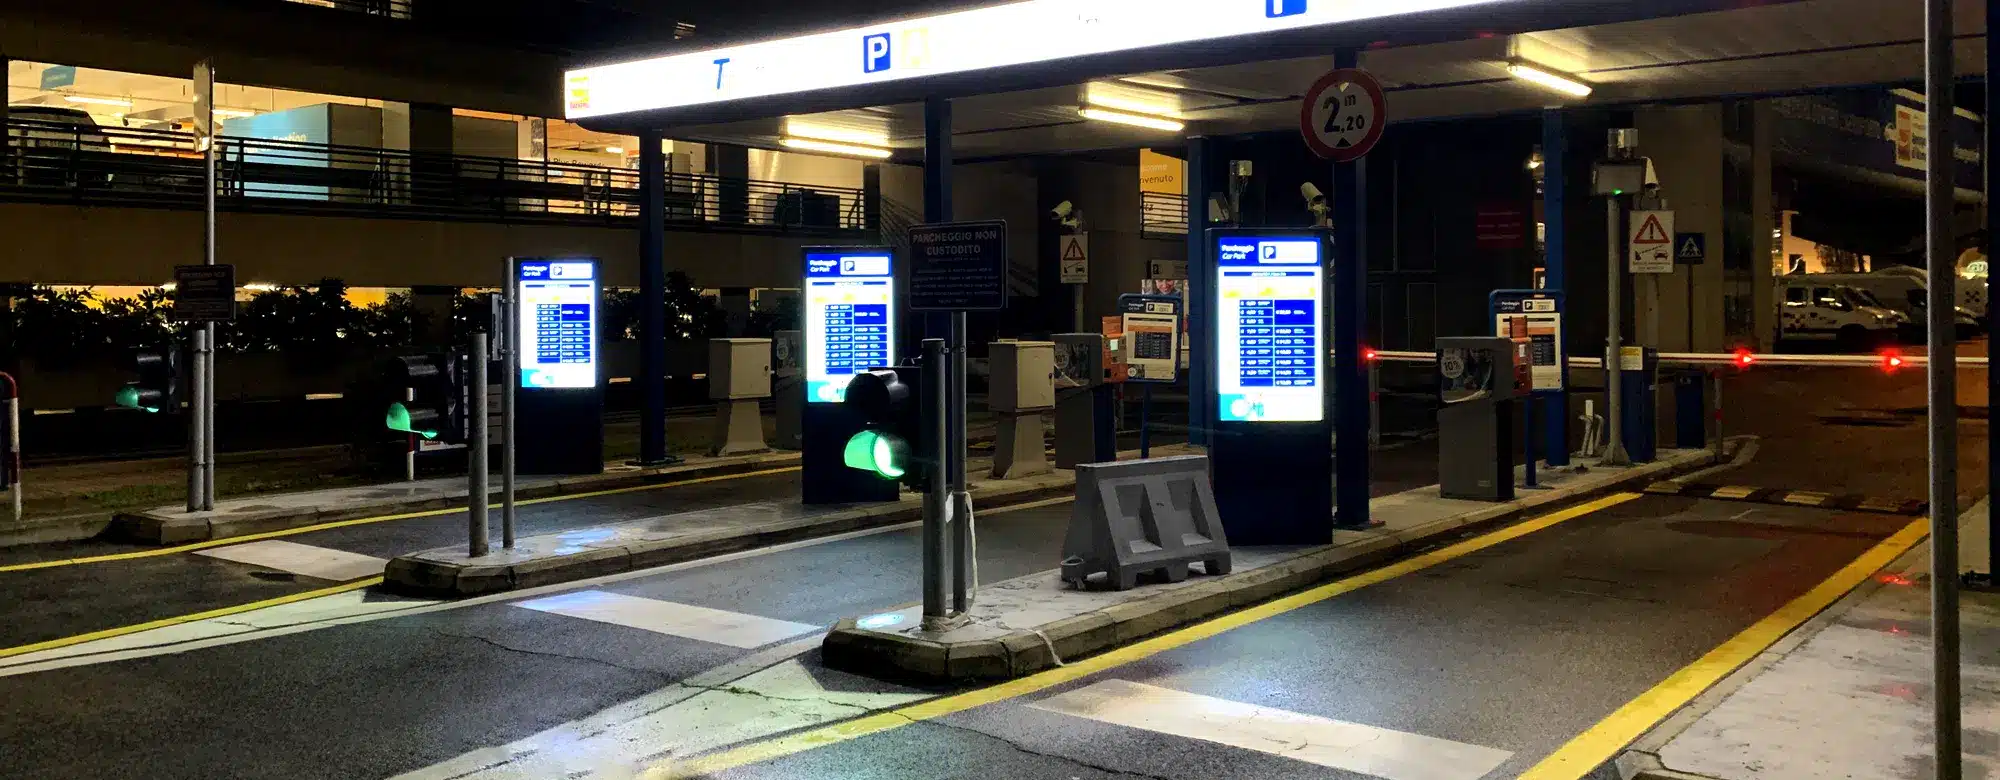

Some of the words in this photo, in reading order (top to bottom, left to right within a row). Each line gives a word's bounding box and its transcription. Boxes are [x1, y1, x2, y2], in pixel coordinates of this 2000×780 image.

[867, 36, 888, 71] P
[912, 231, 972, 244] PARCHEGGIO
[974, 229, 997, 240] NON
[926, 244, 981, 256] CUSTODITO
